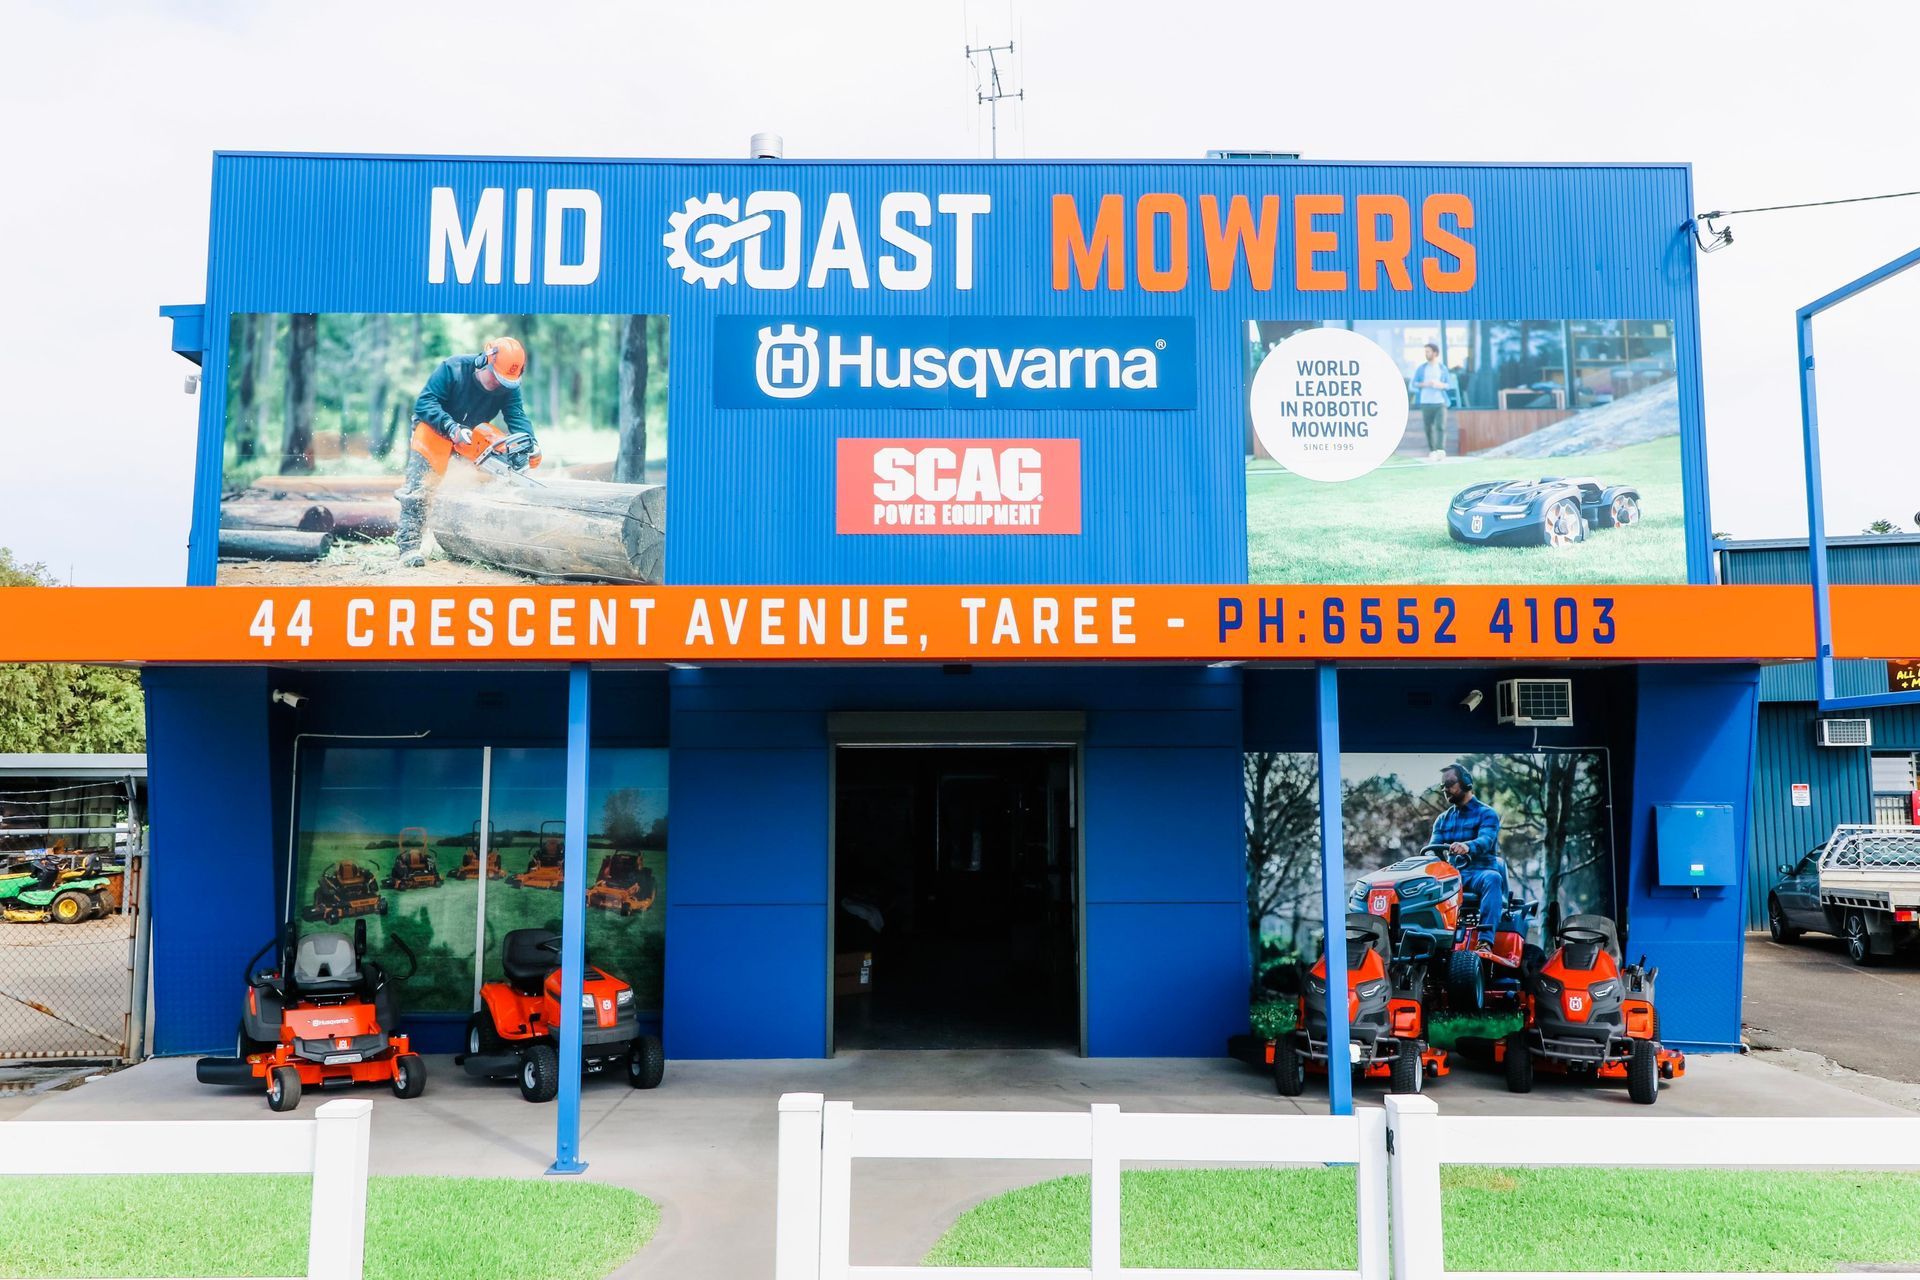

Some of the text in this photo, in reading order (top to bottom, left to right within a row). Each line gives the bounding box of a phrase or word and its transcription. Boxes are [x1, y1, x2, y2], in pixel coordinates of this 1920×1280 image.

[429, 187, 1477, 293] MID COAST MOWERS
[1296, 360, 1360, 376] WORLD
[1295, 380, 1362, 397] LEADER
[1280, 401, 1378, 417] IN ROBOTIC
[1291, 421, 1369, 438] MOWING
[1303, 443, 1354, 451] SINCE 1995
[873, 447, 1042, 502] SCAG
[873, 504, 1042, 526] POWER EQUIPMENT
[249, 599, 313, 647] 44
[346, 598, 656, 647] CRESCENT
[685, 598, 928, 651] AVENUE,
[961, 597, 1136, 645] TAREE
[1218, 597, 1457, 645] PH:6552
[1489, 597, 1616, 645] 4103
[1896, 670, 1916, 680] ALL
